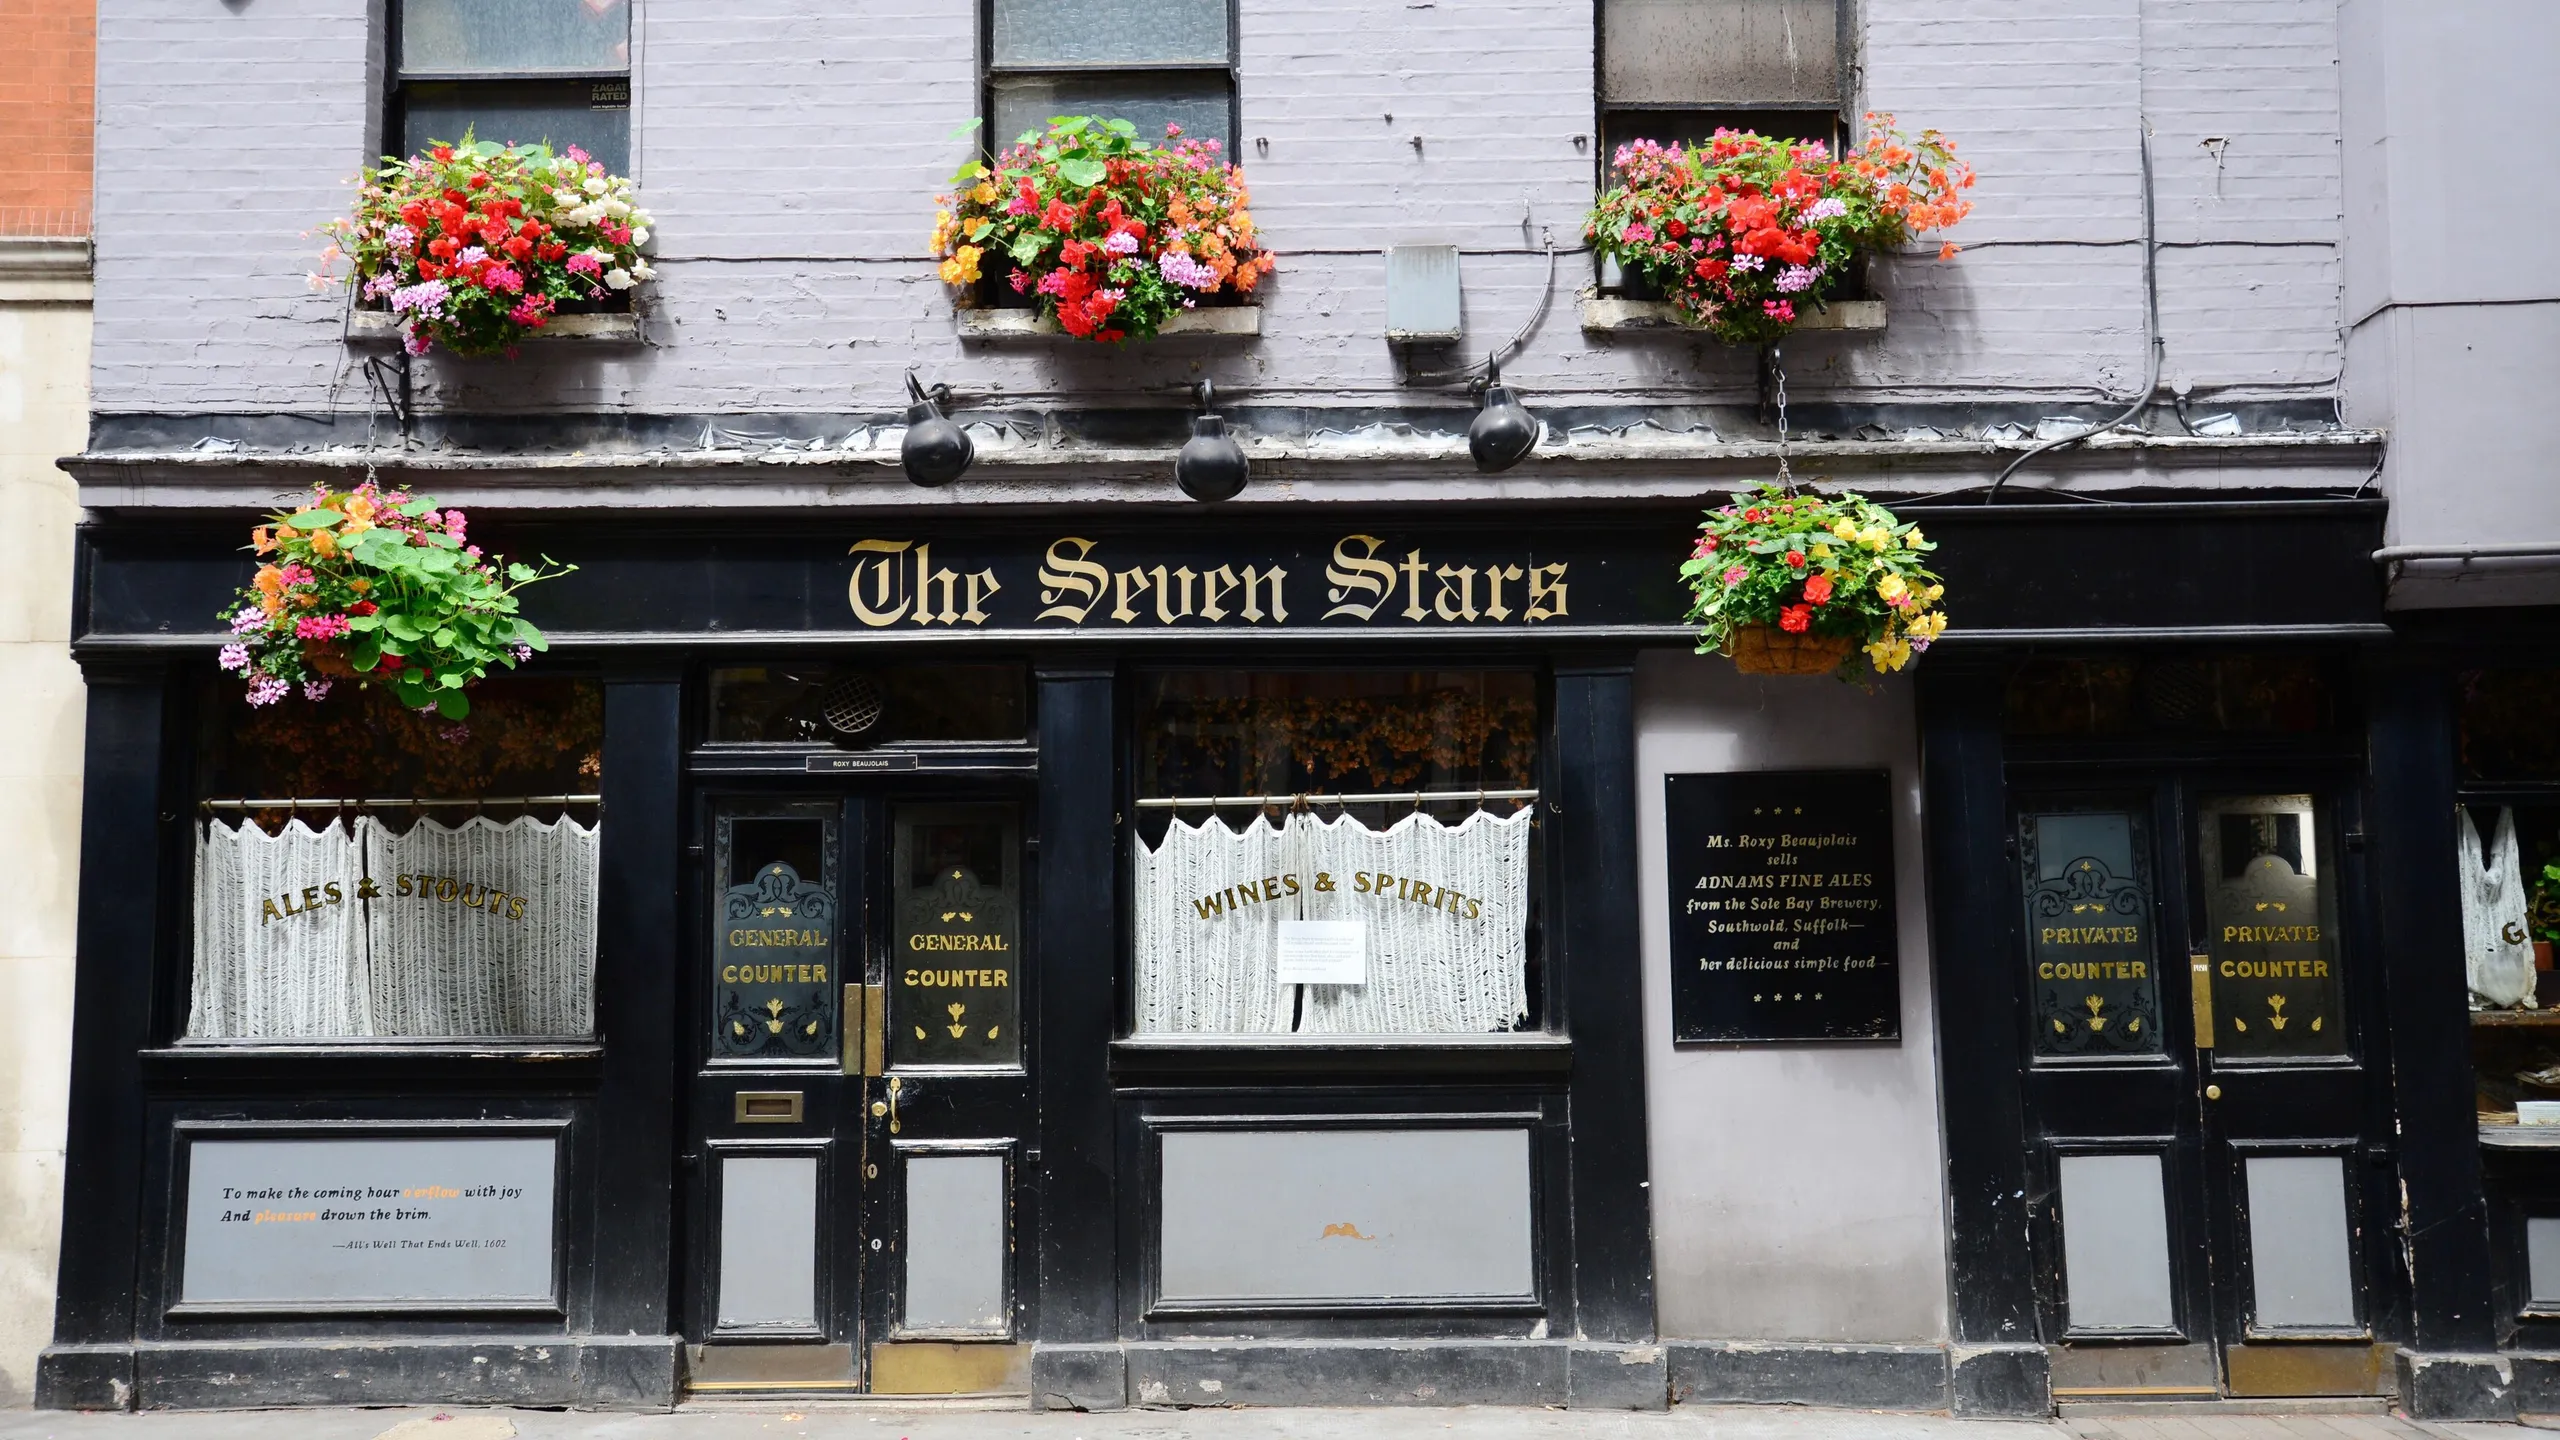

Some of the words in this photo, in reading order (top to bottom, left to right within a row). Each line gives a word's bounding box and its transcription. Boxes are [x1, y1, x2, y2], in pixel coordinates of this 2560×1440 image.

[592, 84, 628, 92] ZAGAT
[592, 92, 628, 101] RATED
[848, 539, 1002, 626] The
[1034, 537, 1289, 625] Seven
[1320, 534, 1569, 623] Stars
[1706, 835, 1733, 848] Ms.
[1738, 834, 1775, 850] Roxy
[1781, 833, 1857, 850] Beaujolais
[1767, 853, 1798, 866] sells
[1695, 874, 1774, 889] ADNAMS
[1779, 873, 1823, 888] FINE
[1828, 873, 1872, 887] ALES
[261, 881, 342, 927] ALES
[357, 877, 382, 900] &
[396, 873, 528, 920] STOUTS
[1193, 873, 1301, 920] WINES
[1314, 872, 1336, 892] &
[1354, 871, 1483, 920] SPIRITS
[1686, 898, 1721, 915] from
[1725, 897, 1746, 910] the
[1750, 897, 1780, 910] Sole
[1785, 896, 1814, 912] Bay
[1820, 896, 1882, 911] Brewery,
[729, 929, 828, 947] GENERAL
[909, 934, 1008, 951] GENERAL
[2041, 926, 2138, 945] PRIVATE
[2223, 925, 2320, 943] PRIVATE
[1773, 938, 1800, 951] and
[1700, 957, 1722, 971] her
[1726, 957, 1789, 970] delicious
[1793, 956, 1839, 972] simple
[2038, 960, 2147, 980] COUNTER
[2219, 960, 2328, 978] COUNTER
[722, 964, 827, 983] COUNTER
[904, 969, 1008, 988] COUNTER
[223, 1188, 242, 1199] To
[246, 1187, 283, 1199] make
[288, 1187, 309, 1199] the
[314, 1186, 362, 1201] coming
[367, 1186, 400, 1198] hour
[465, 1185, 496, 1197] with
[499, 1185, 522, 1200] joy
[220, 1210, 251, 1222] And
[254, 1209, 317, 1225] pleasure
[321, 1208, 365, 1221] drown
[370, 1208, 391, 1220] the
[396, 1207, 431, 1220] brim.
[373, 1240, 396, 1249] Well
[400, 1240, 424, 1249] That
[427, 1240, 451, 1249] Ends
[455, 1239, 481, 1249] Well,
[484, 1239, 506, 1248] 1602
